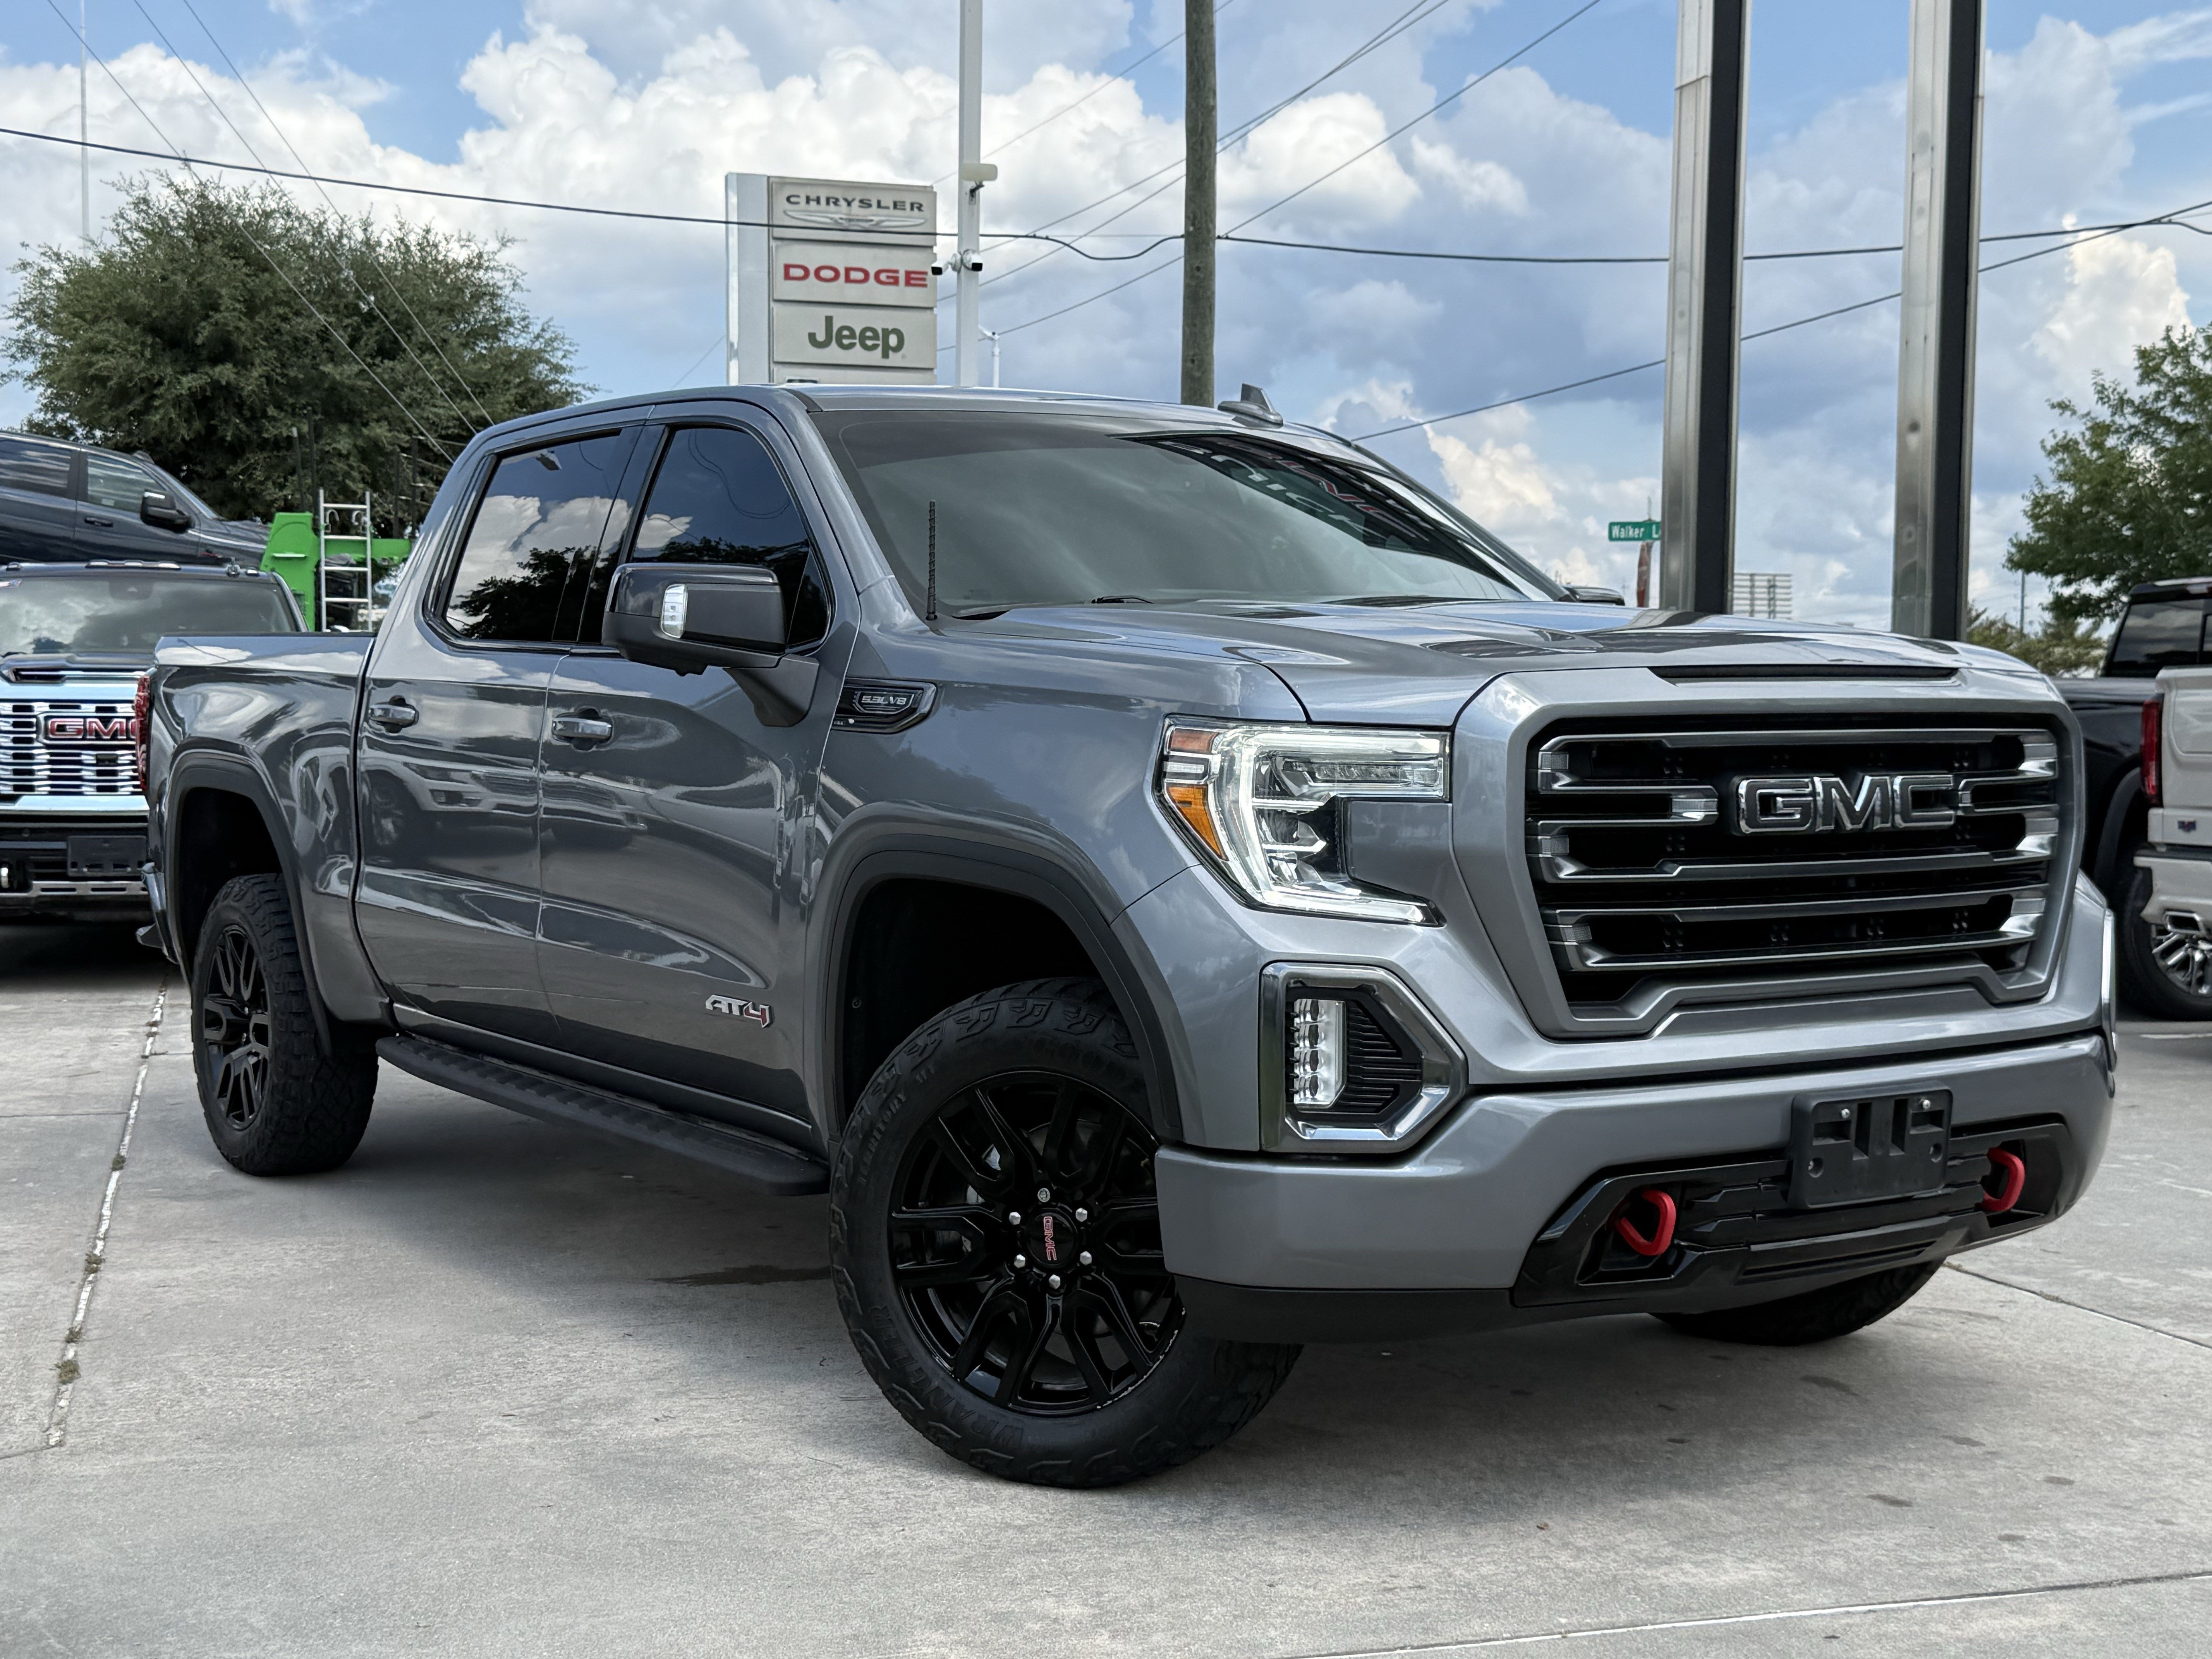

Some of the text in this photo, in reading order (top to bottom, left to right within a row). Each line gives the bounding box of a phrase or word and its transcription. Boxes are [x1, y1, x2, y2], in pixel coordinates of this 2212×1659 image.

[786, 194, 924, 212] CHRYSLER
[783, 263, 928, 288] DODGE
[808, 315, 905, 359] Jeep
[1611, 524, 1661, 539] Walker L
[49, 718, 136, 739] GM
[1738, 775, 1956, 833] GMC
[705, 994, 770, 1028] AT4
[1043, 1216, 1057, 1261] GMC
[870, 1305, 1024, 1443] WRANGLER
